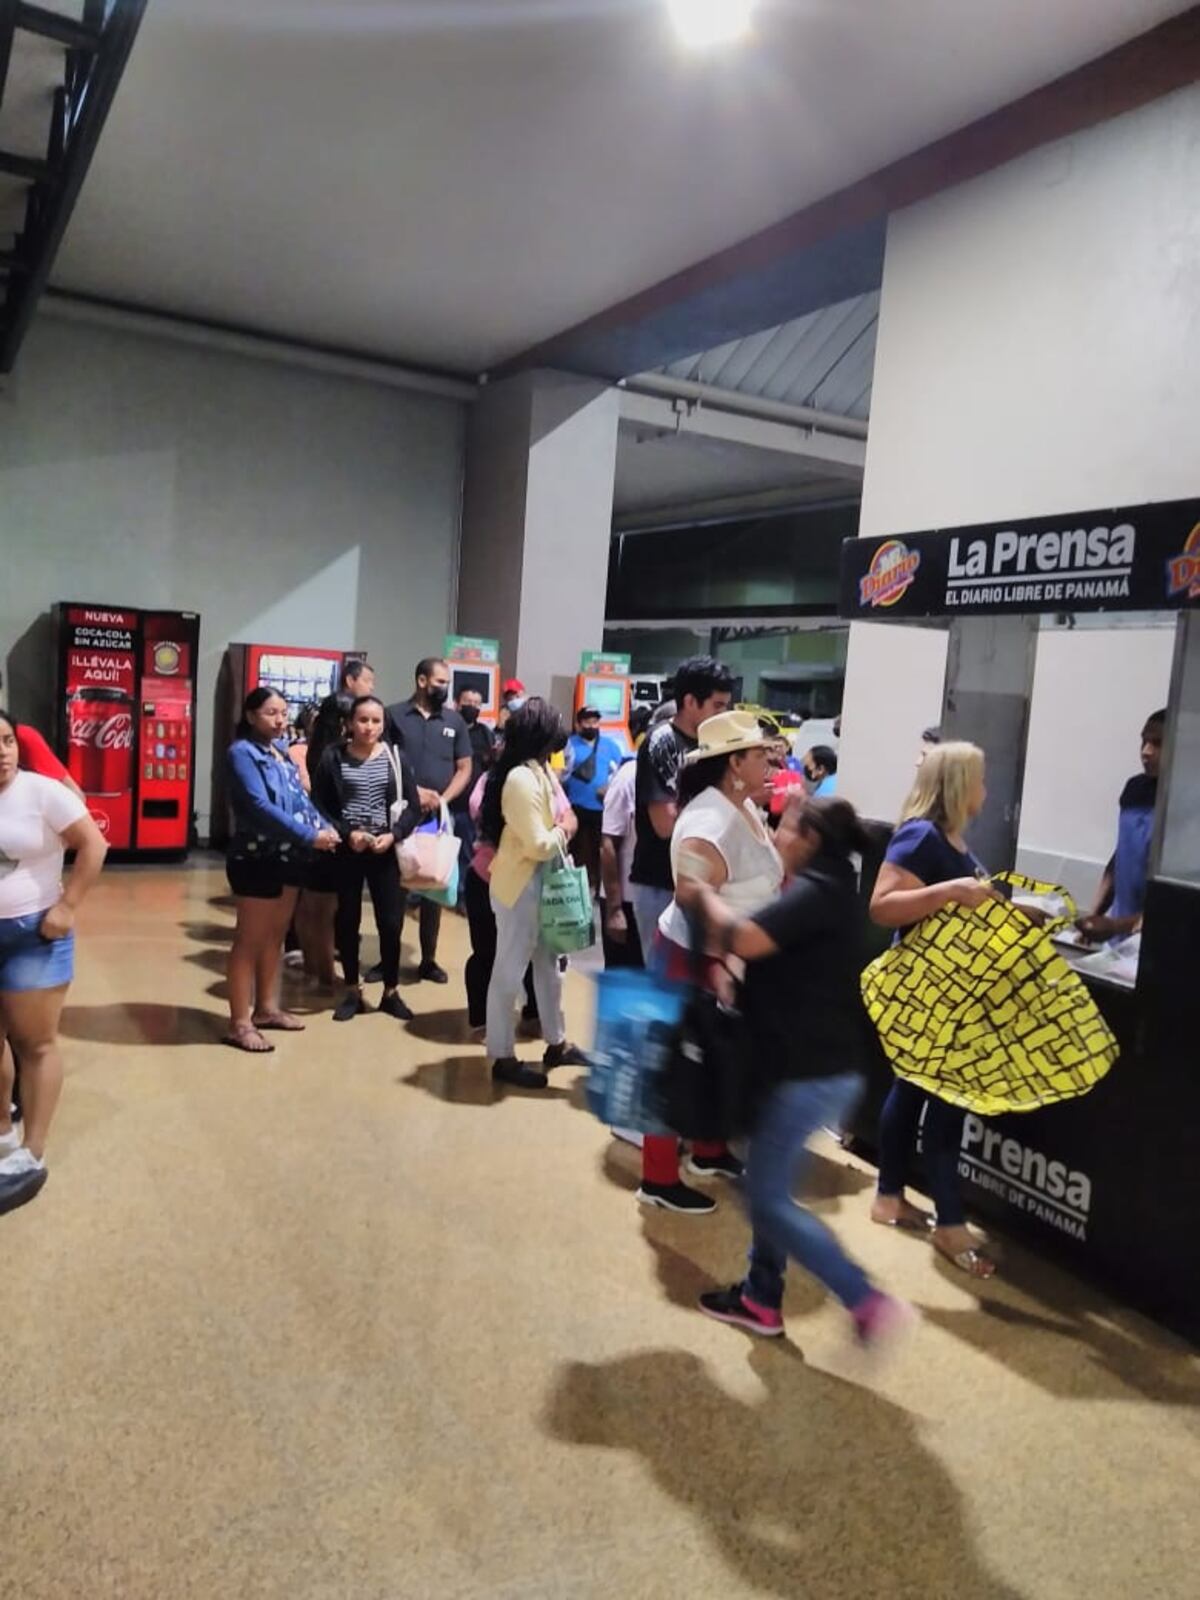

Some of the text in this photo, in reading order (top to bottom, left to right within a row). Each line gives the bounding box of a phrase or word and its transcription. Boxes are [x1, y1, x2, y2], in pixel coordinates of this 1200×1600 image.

[947, 523, 1136, 578] La Prensa
[945, 576, 1130, 606] EL DIARIO LIBRE DE PANAMÁ
[84, 611, 125, 624] NUEVA
[74, 637, 91, 646] SIN
[75, 627, 132, 640] COCA-COLA
[961, 1113, 1092, 1213] Prensa
[1008, 1188, 1026, 1211] DE
